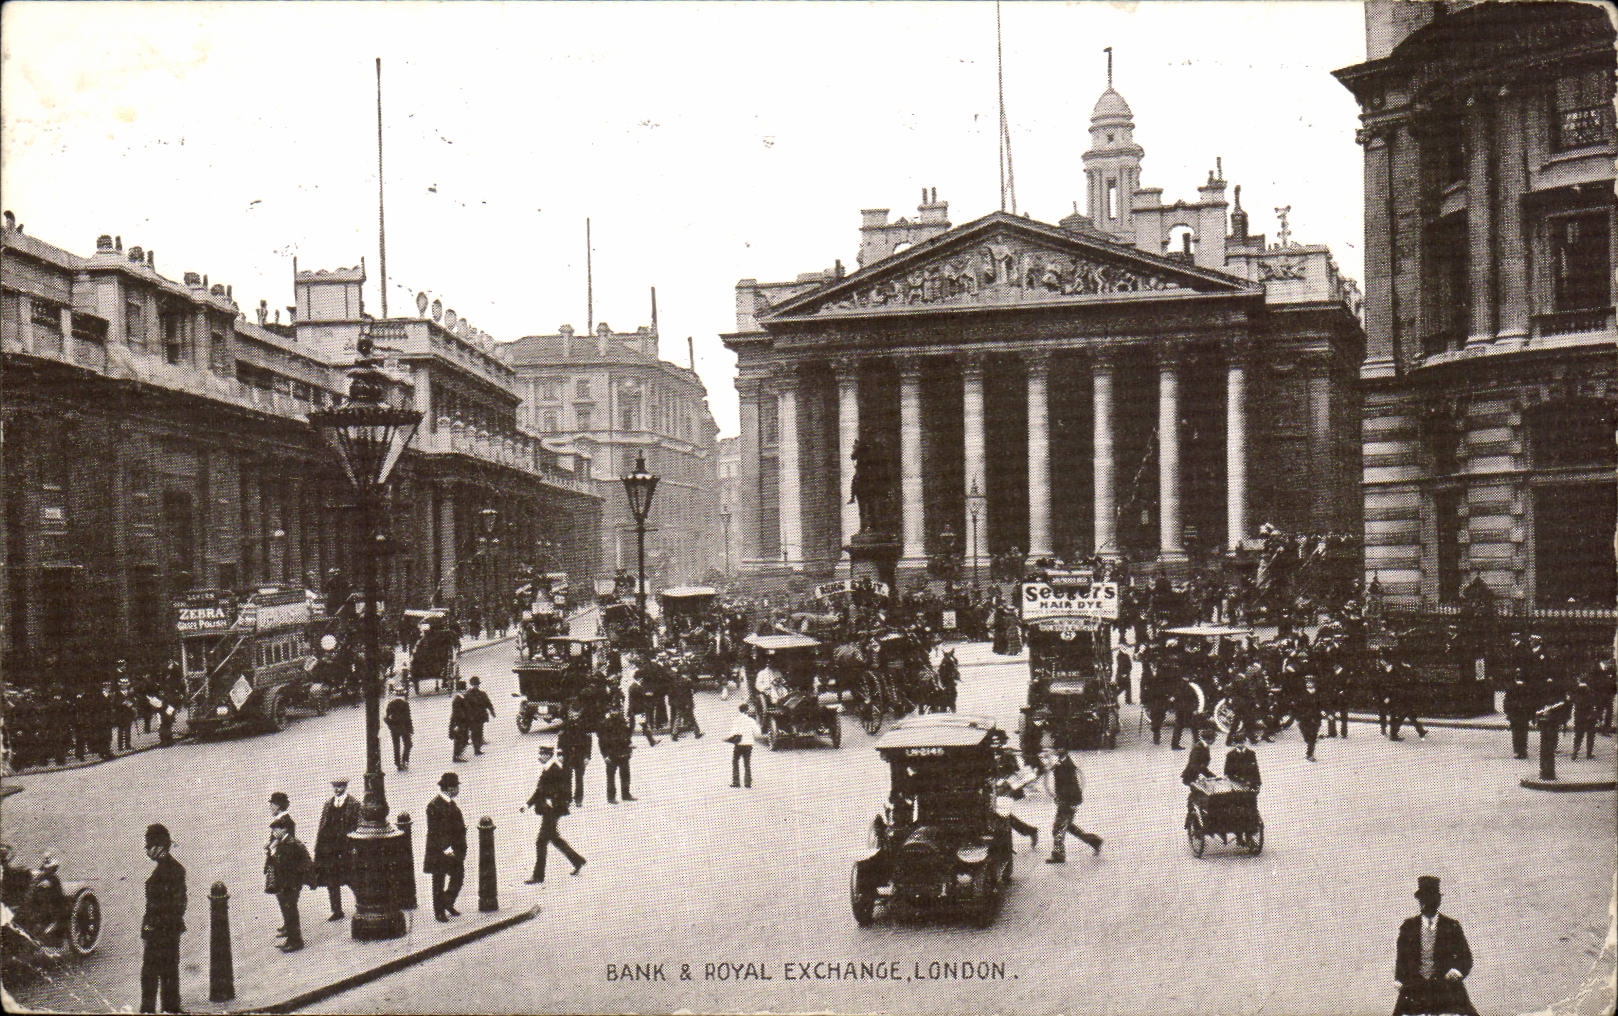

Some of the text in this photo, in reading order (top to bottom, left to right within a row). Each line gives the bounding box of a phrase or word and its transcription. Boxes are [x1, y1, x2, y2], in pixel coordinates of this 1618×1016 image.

[1026, 586, 1115, 601] Seers
[1040, 601, 1102, 609] HAIR DYE
[179, 607, 226, 621] ZEBRA
